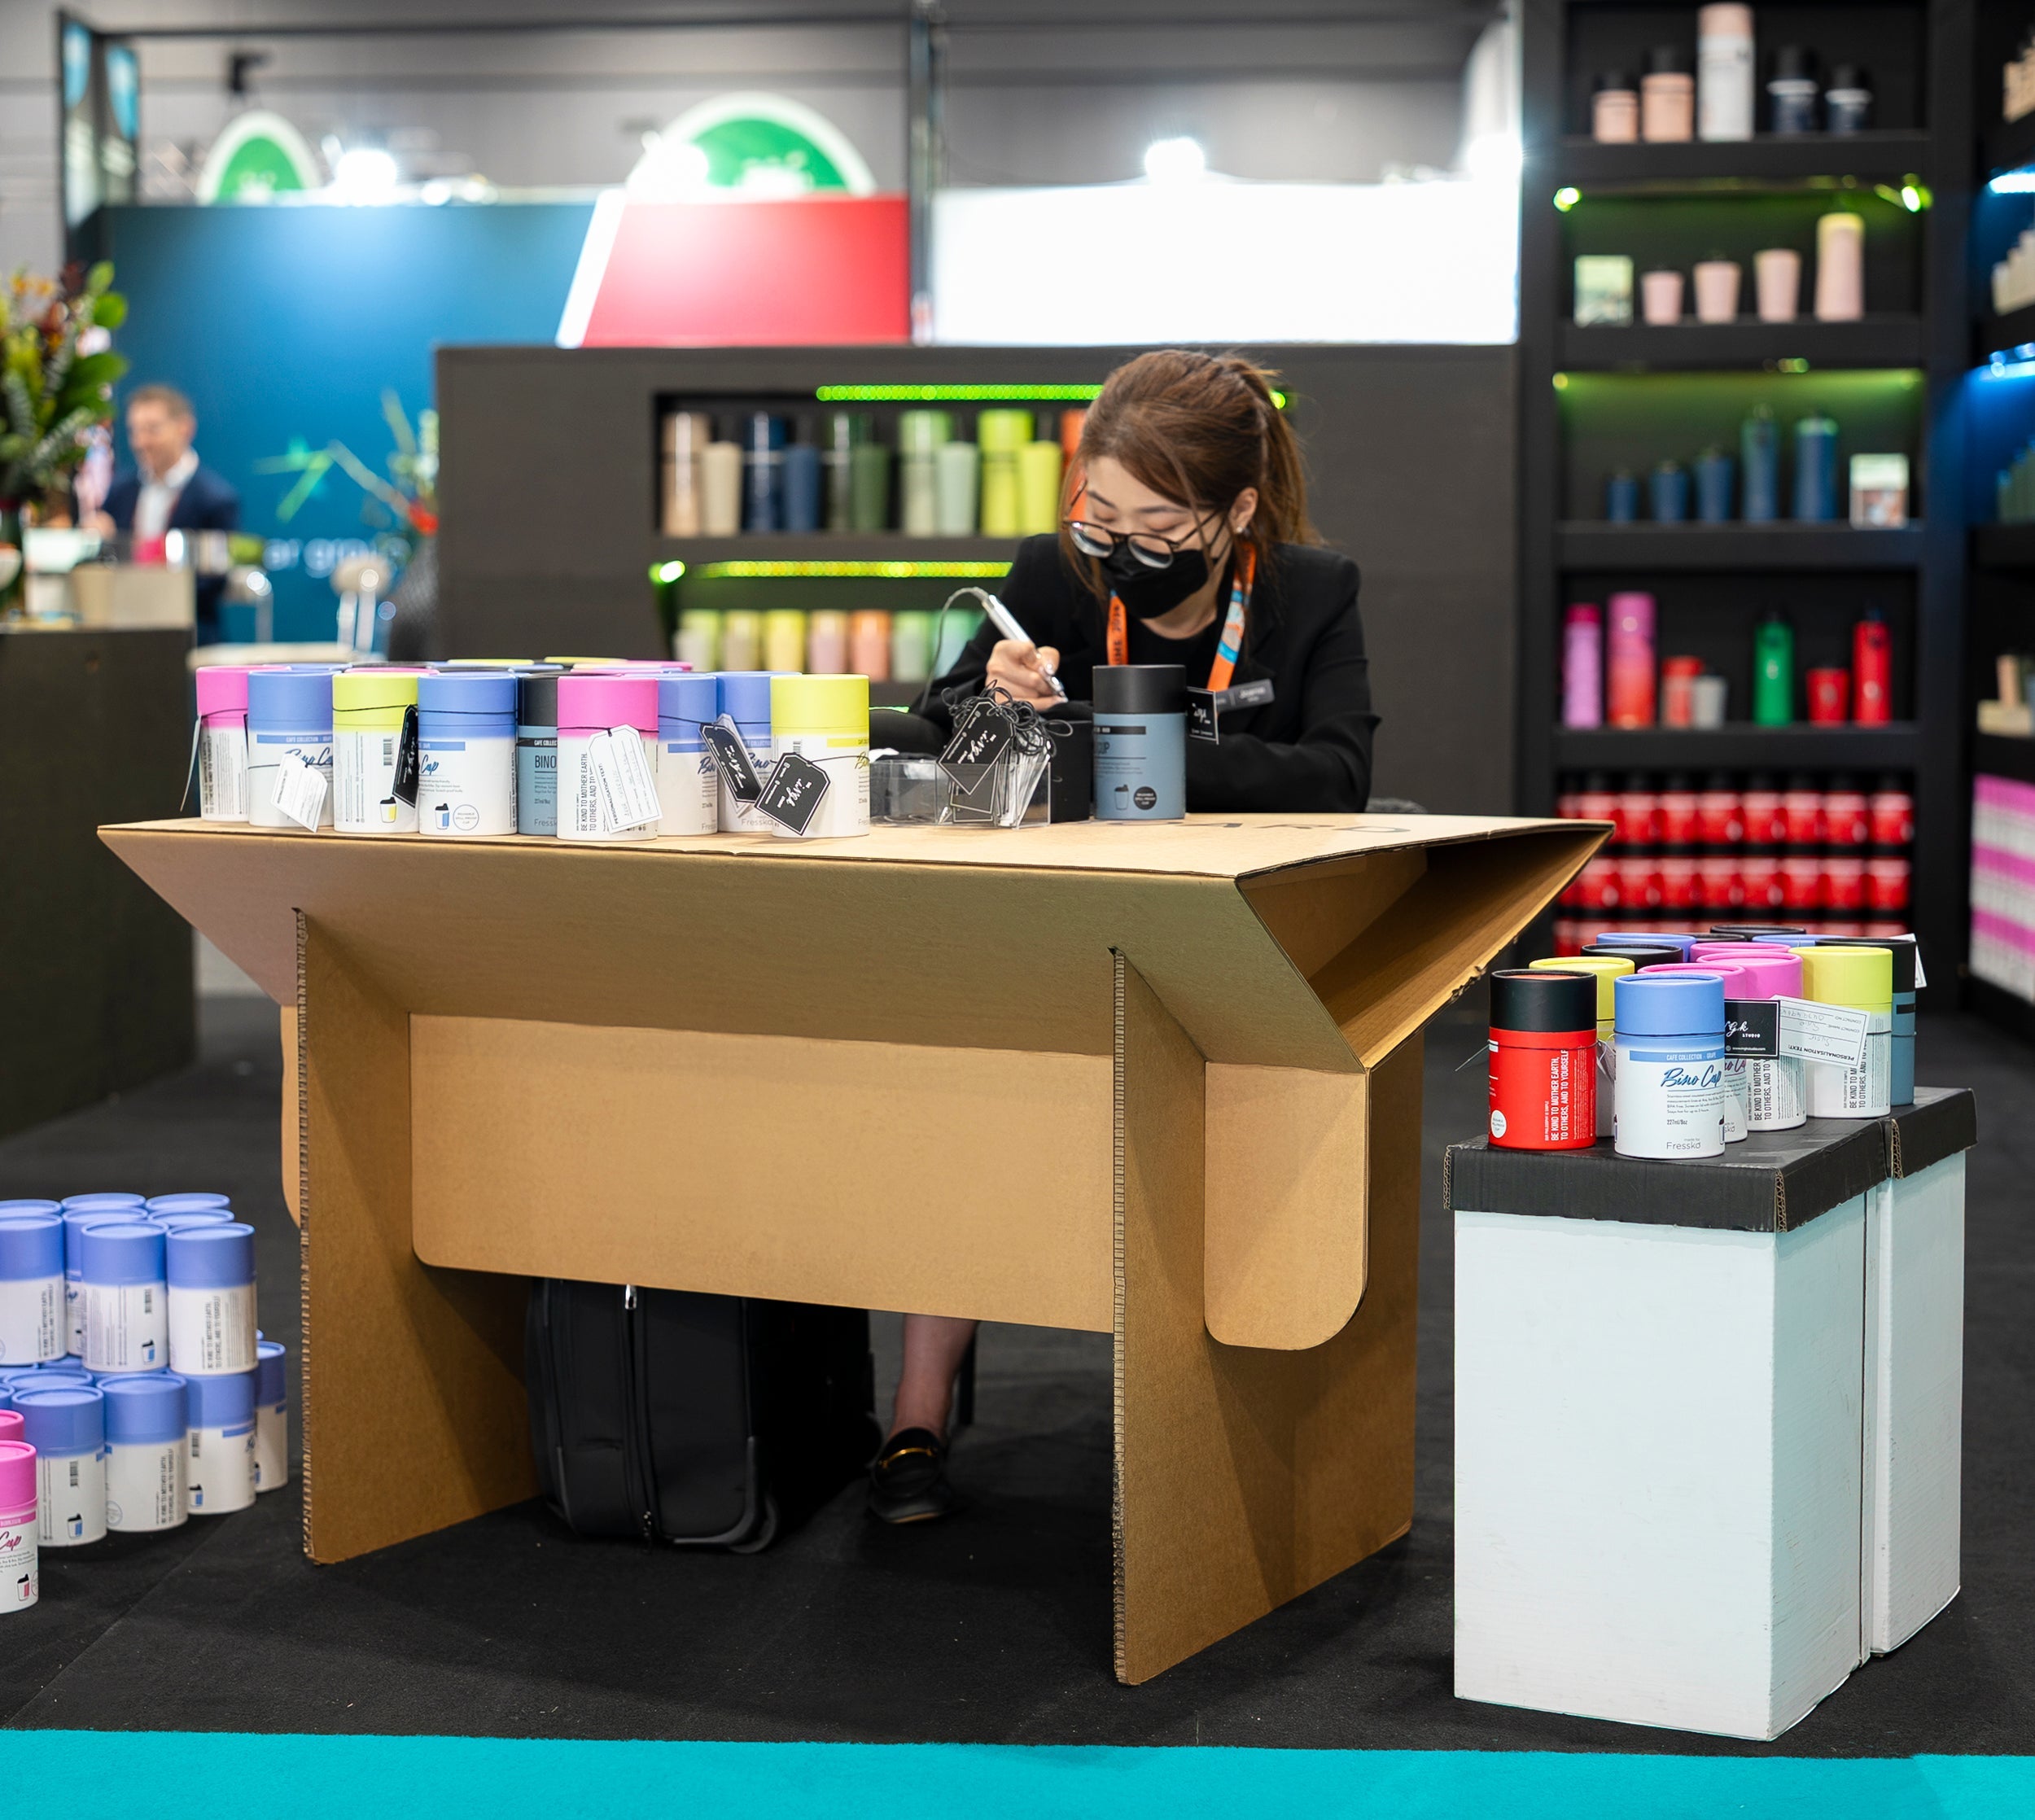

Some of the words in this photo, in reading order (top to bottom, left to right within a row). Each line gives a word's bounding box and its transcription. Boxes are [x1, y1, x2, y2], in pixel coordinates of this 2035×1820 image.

[589, 823, 597, 831] TO
[1666, 1052, 1678, 1061] CAFE
[1678, 1052, 1703, 1061] COLLECTION
[1803, 1047, 1854, 1061] PERSONALISATION
[1560, 1049, 1569, 1081] YOURSELF
[1661, 1067, 1700, 1087] Bino
[1700, 1064, 1722, 1088] Cup
[1763, 1073, 1771, 1085] AND
[1560, 1081, 1569, 1090] TO
[1551, 1079, 1559, 1106] MOTHER
[1849, 1085, 1858, 1100] KIND
[1560, 1091, 1569, 1105] AND
[1849, 1100, 1858, 1109] BE
[1551, 1107, 1559, 1116] TO
[1754, 1113, 1762, 1121] BE
[1551, 1117, 1560, 1131] KIND
[1551, 1132, 1560, 1141] BE
[1560, 1131, 1569, 1140] TO
